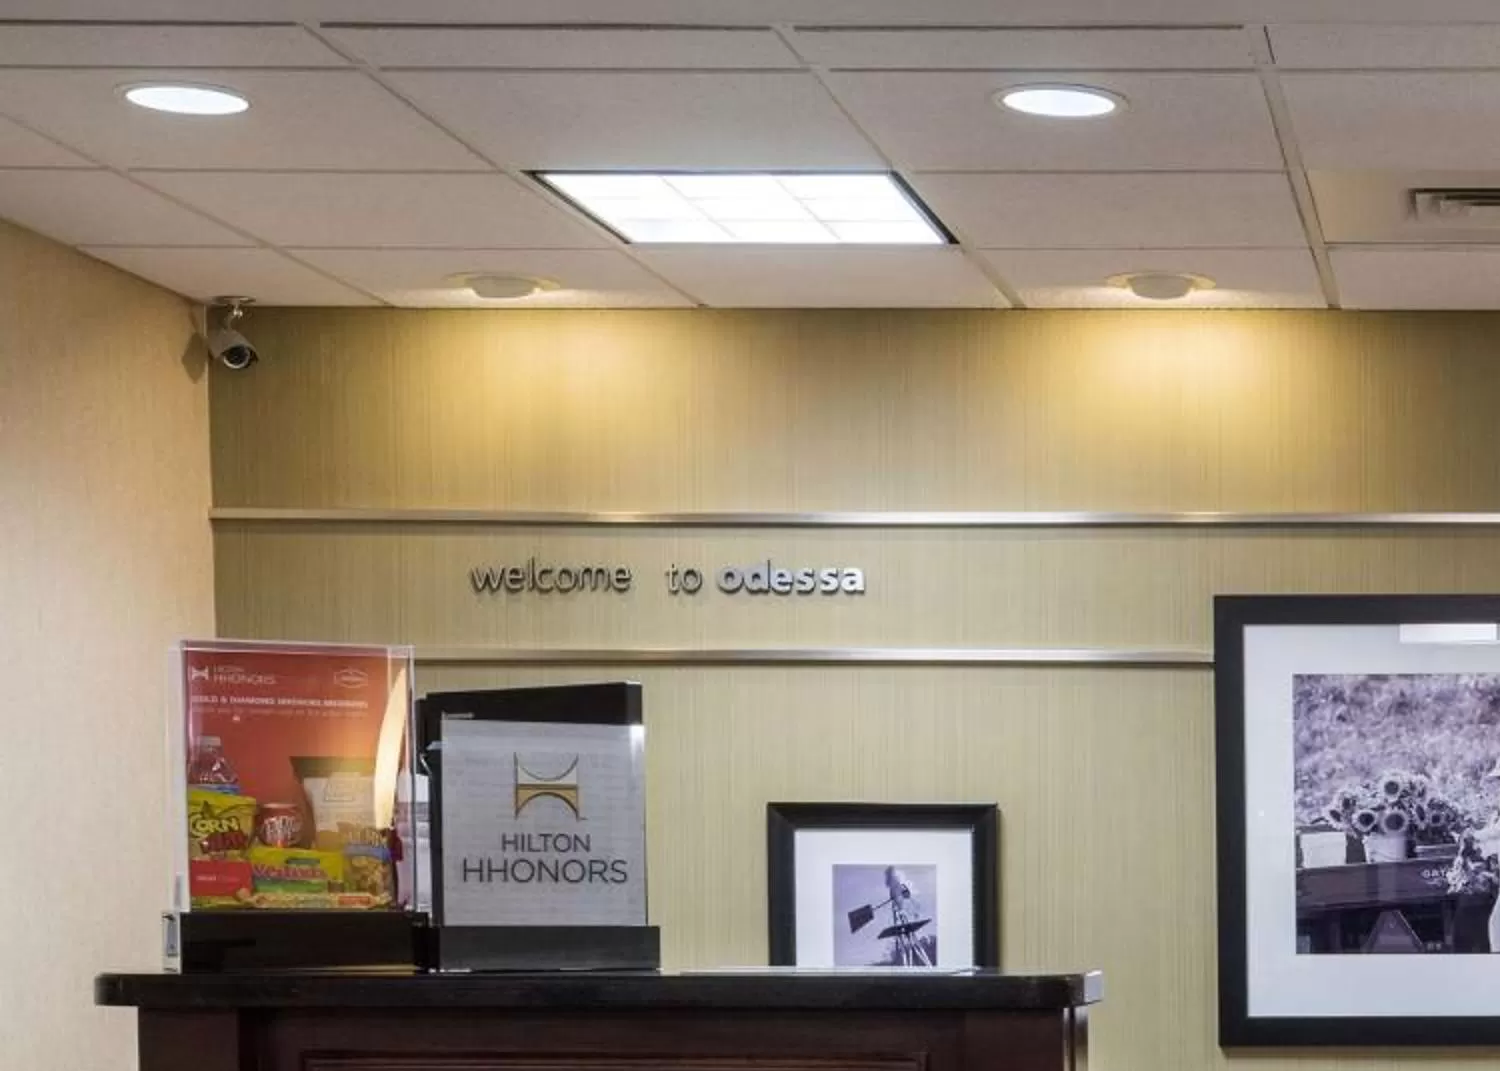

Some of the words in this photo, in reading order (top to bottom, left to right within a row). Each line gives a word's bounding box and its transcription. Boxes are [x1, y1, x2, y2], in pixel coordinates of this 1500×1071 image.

[470, 558, 632, 594] welcome
[666, 563, 702, 594] to
[717, 558, 866, 595] odessa
[501, 833, 592, 854] HILTON
[462, 857, 629, 884] HHONORS
